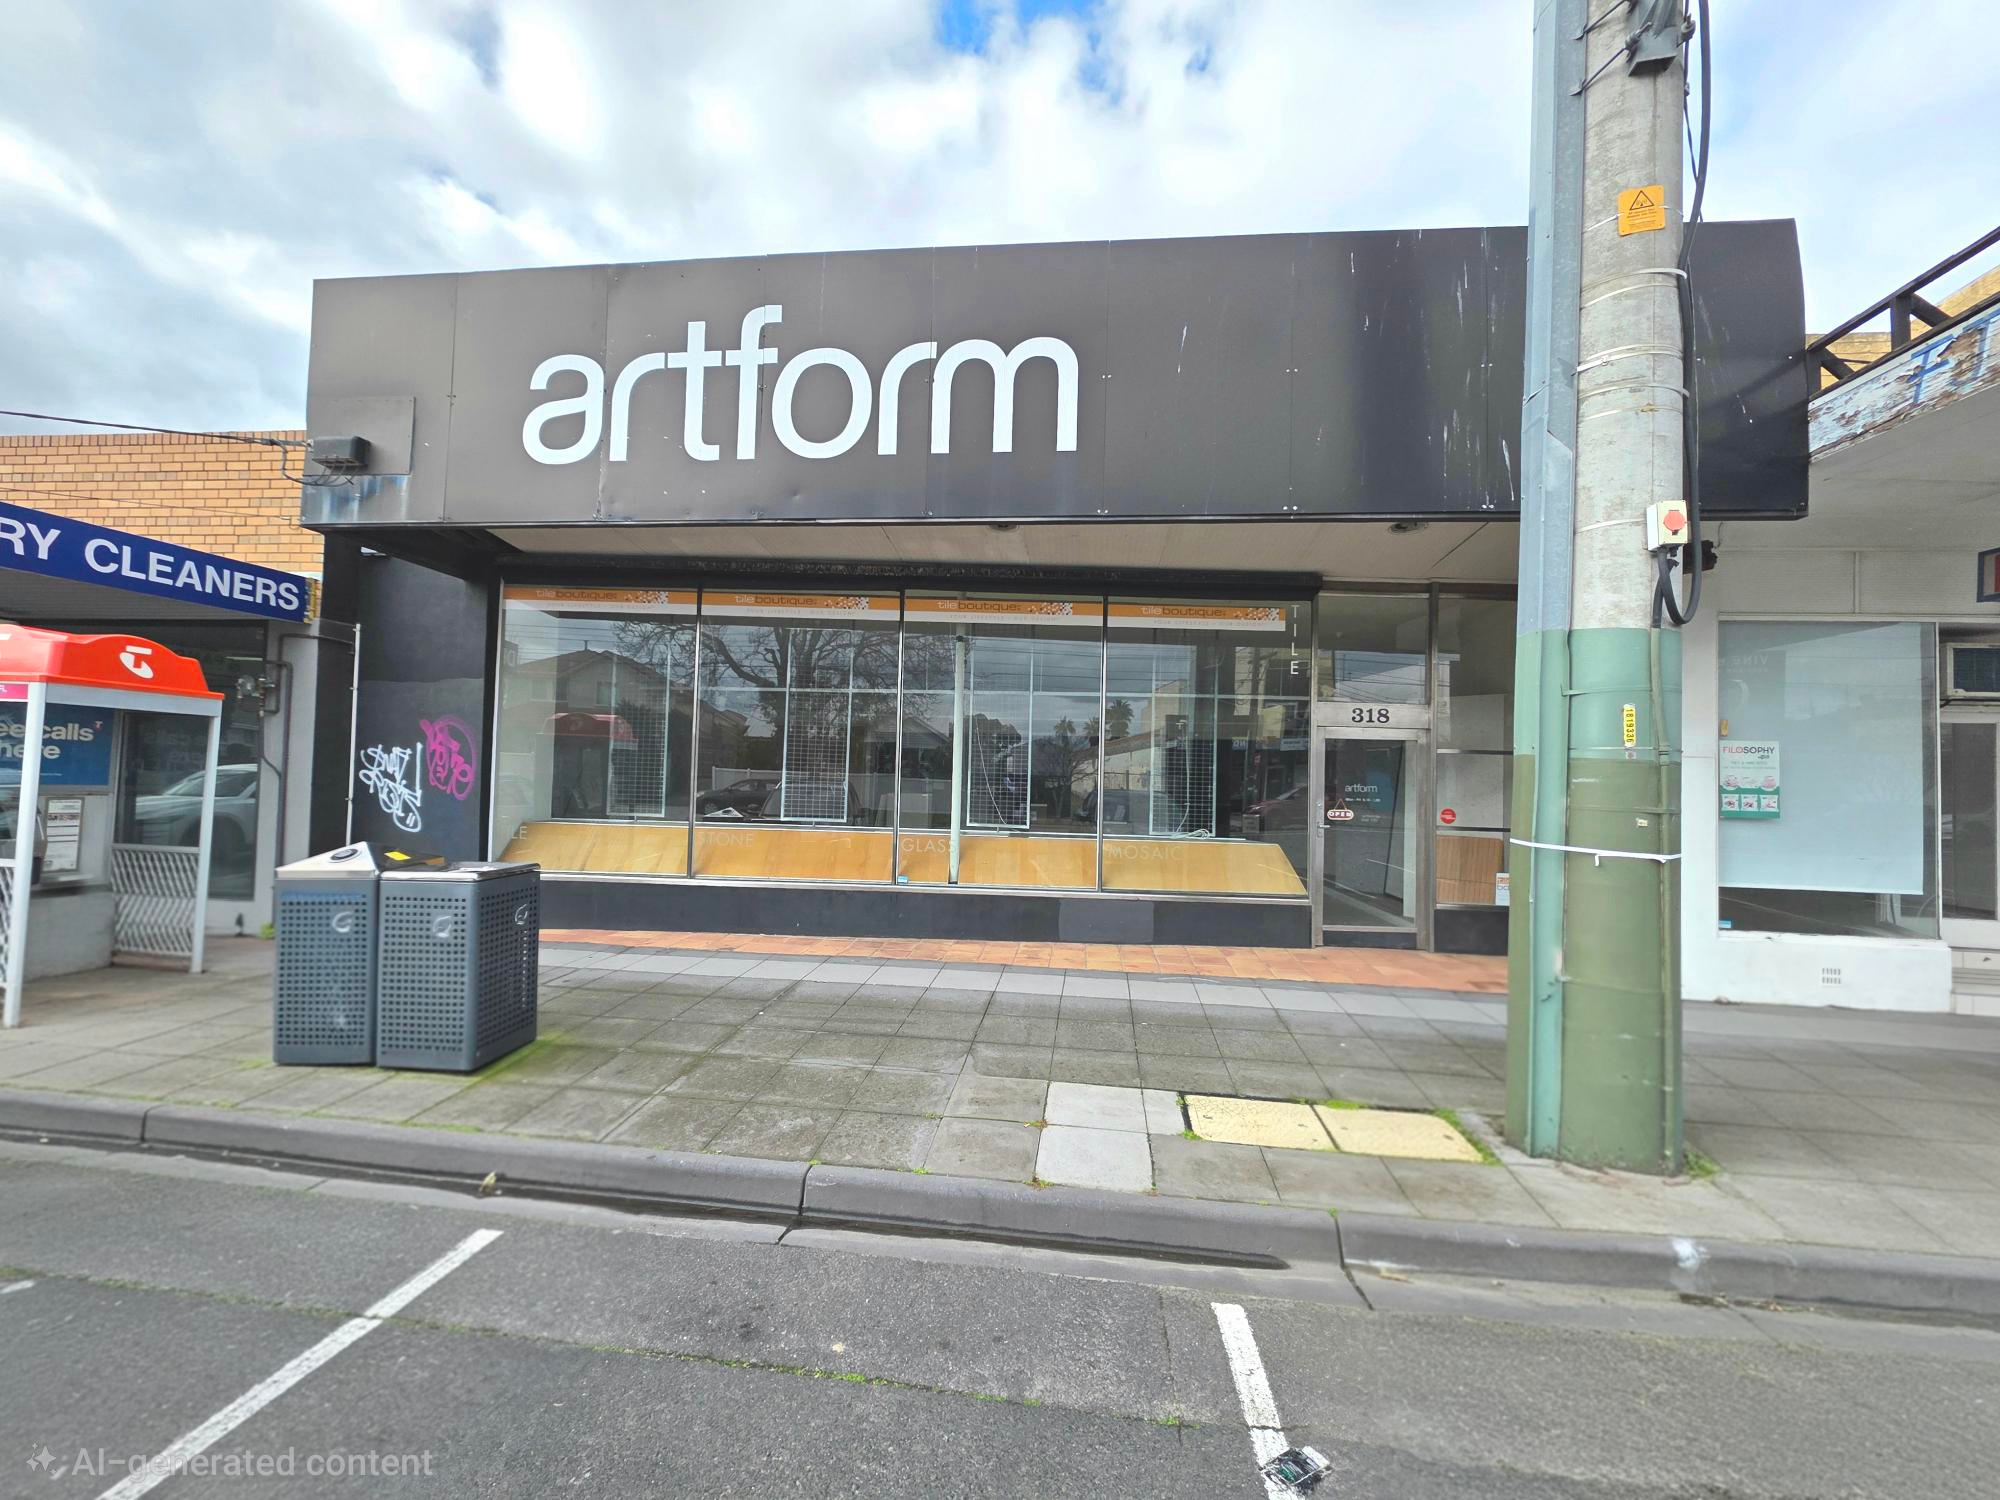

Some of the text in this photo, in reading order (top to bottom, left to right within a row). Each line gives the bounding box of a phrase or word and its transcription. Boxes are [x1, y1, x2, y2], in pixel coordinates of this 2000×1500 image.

[522, 304, 1080, 465] artform
[84, 538, 300, 611] CLEANERS
[1351, 707, 1390, 723] 318
[1722, 746, 1775, 754] FILOSOPHY
[1344, 783, 1378, 793] artform
